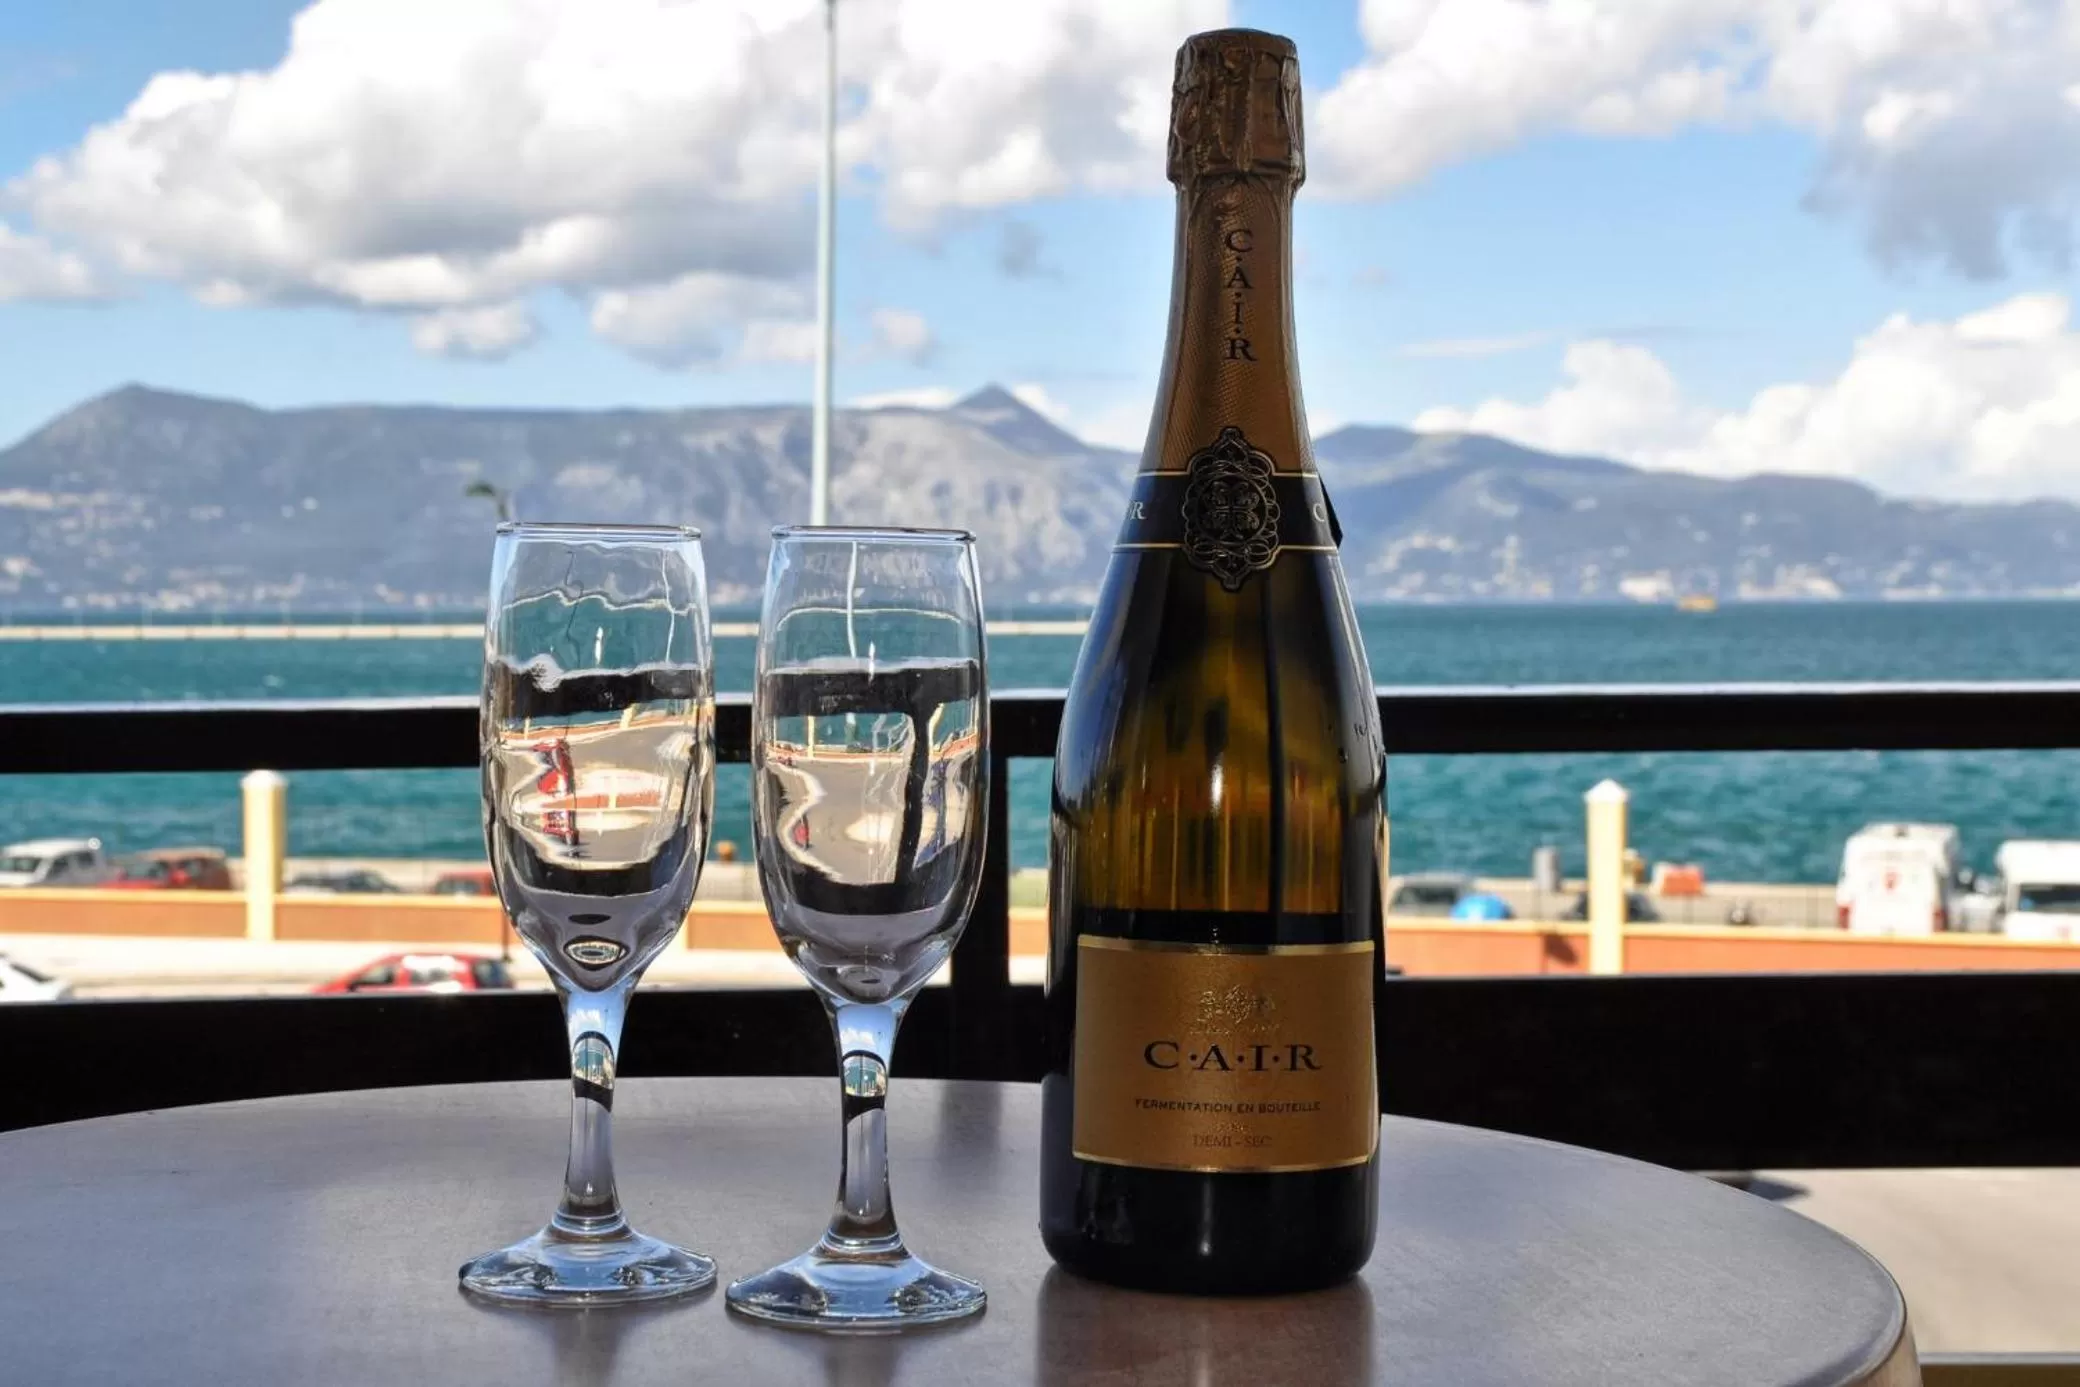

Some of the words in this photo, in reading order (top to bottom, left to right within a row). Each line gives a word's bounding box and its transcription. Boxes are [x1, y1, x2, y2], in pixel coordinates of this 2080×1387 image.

[1135, 1098, 1233, 1113] FERMENTATION
[1237, 1102, 1254, 1114] EN
[1258, 1101, 1321, 1114] BOUTEILLE
